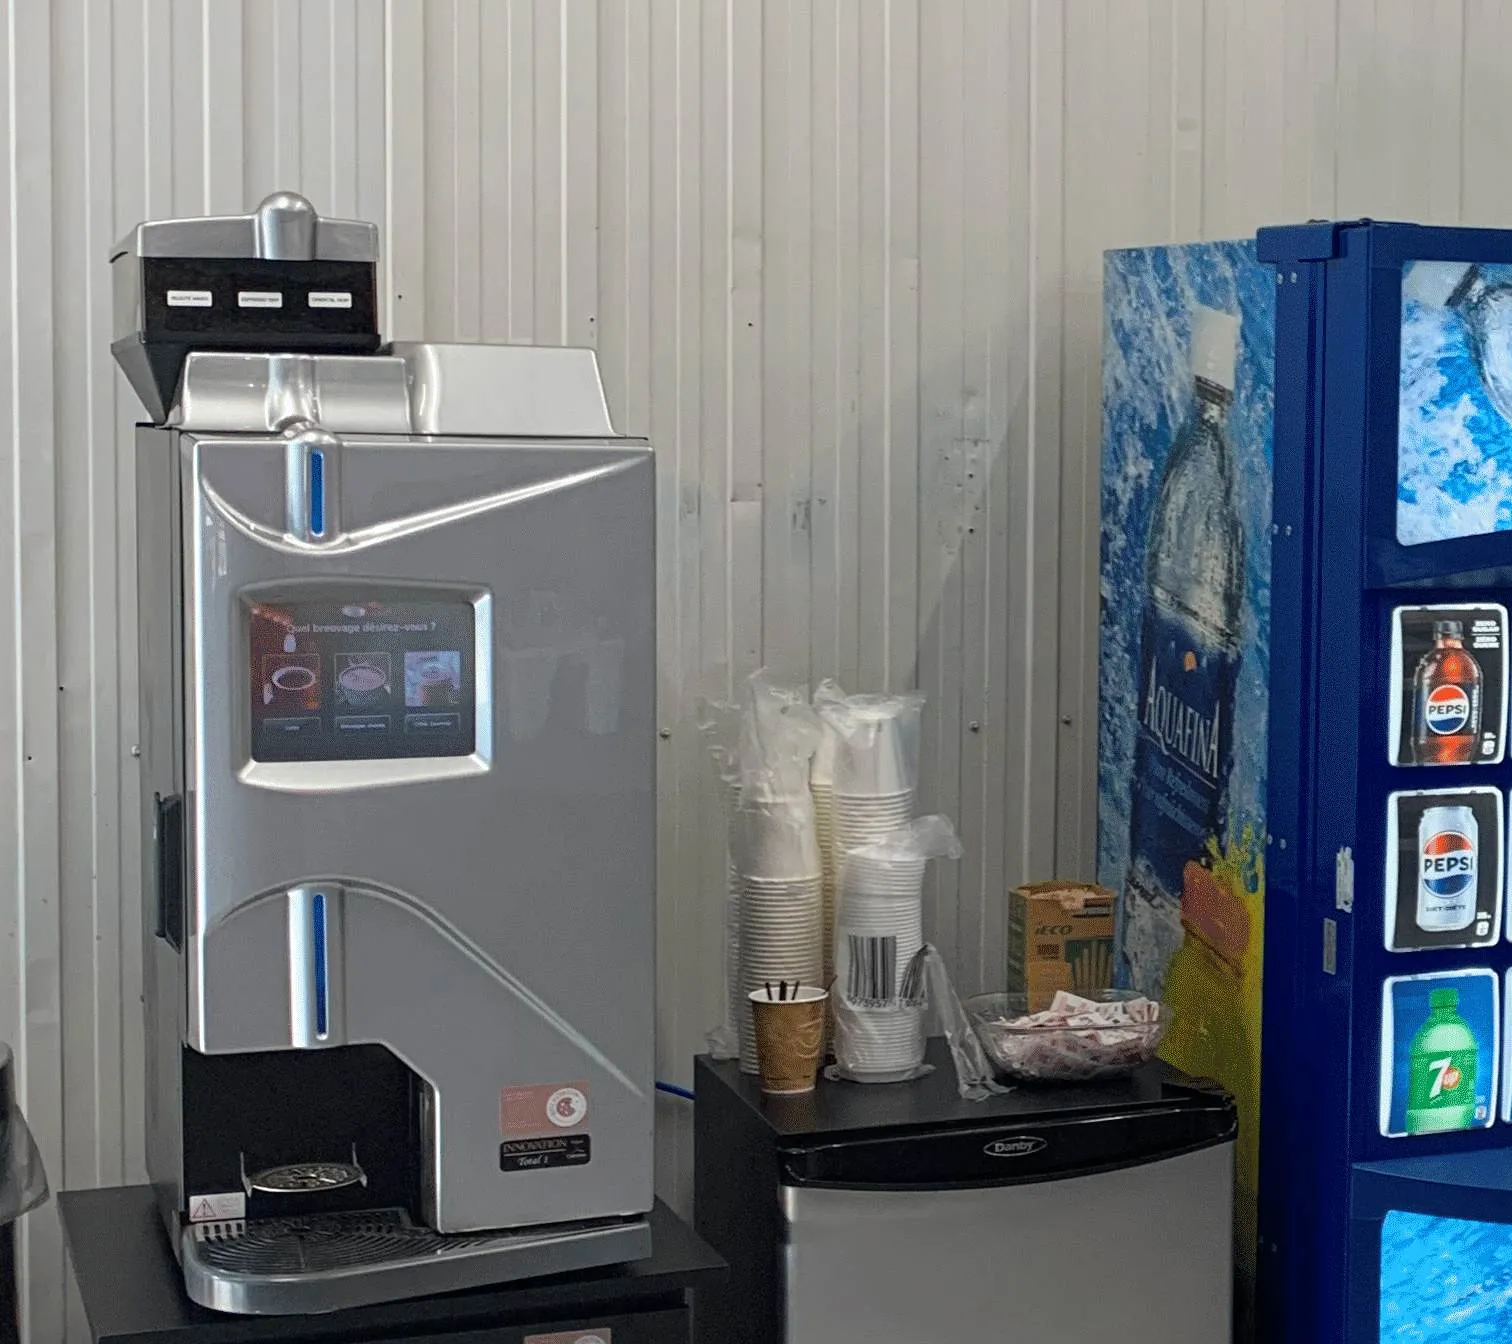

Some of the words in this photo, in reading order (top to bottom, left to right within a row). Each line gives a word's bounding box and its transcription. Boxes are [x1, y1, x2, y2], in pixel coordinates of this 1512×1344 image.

[1144, 655, 1219, 778] AQUAFINA
[1428, 704, 1466, 715] PEPSI
[1424, 856, 1473, 872] PEPSI
[503, 1138, 567, 1153] INNOVATION
[995, 1141, 1037, 1152] Danby
